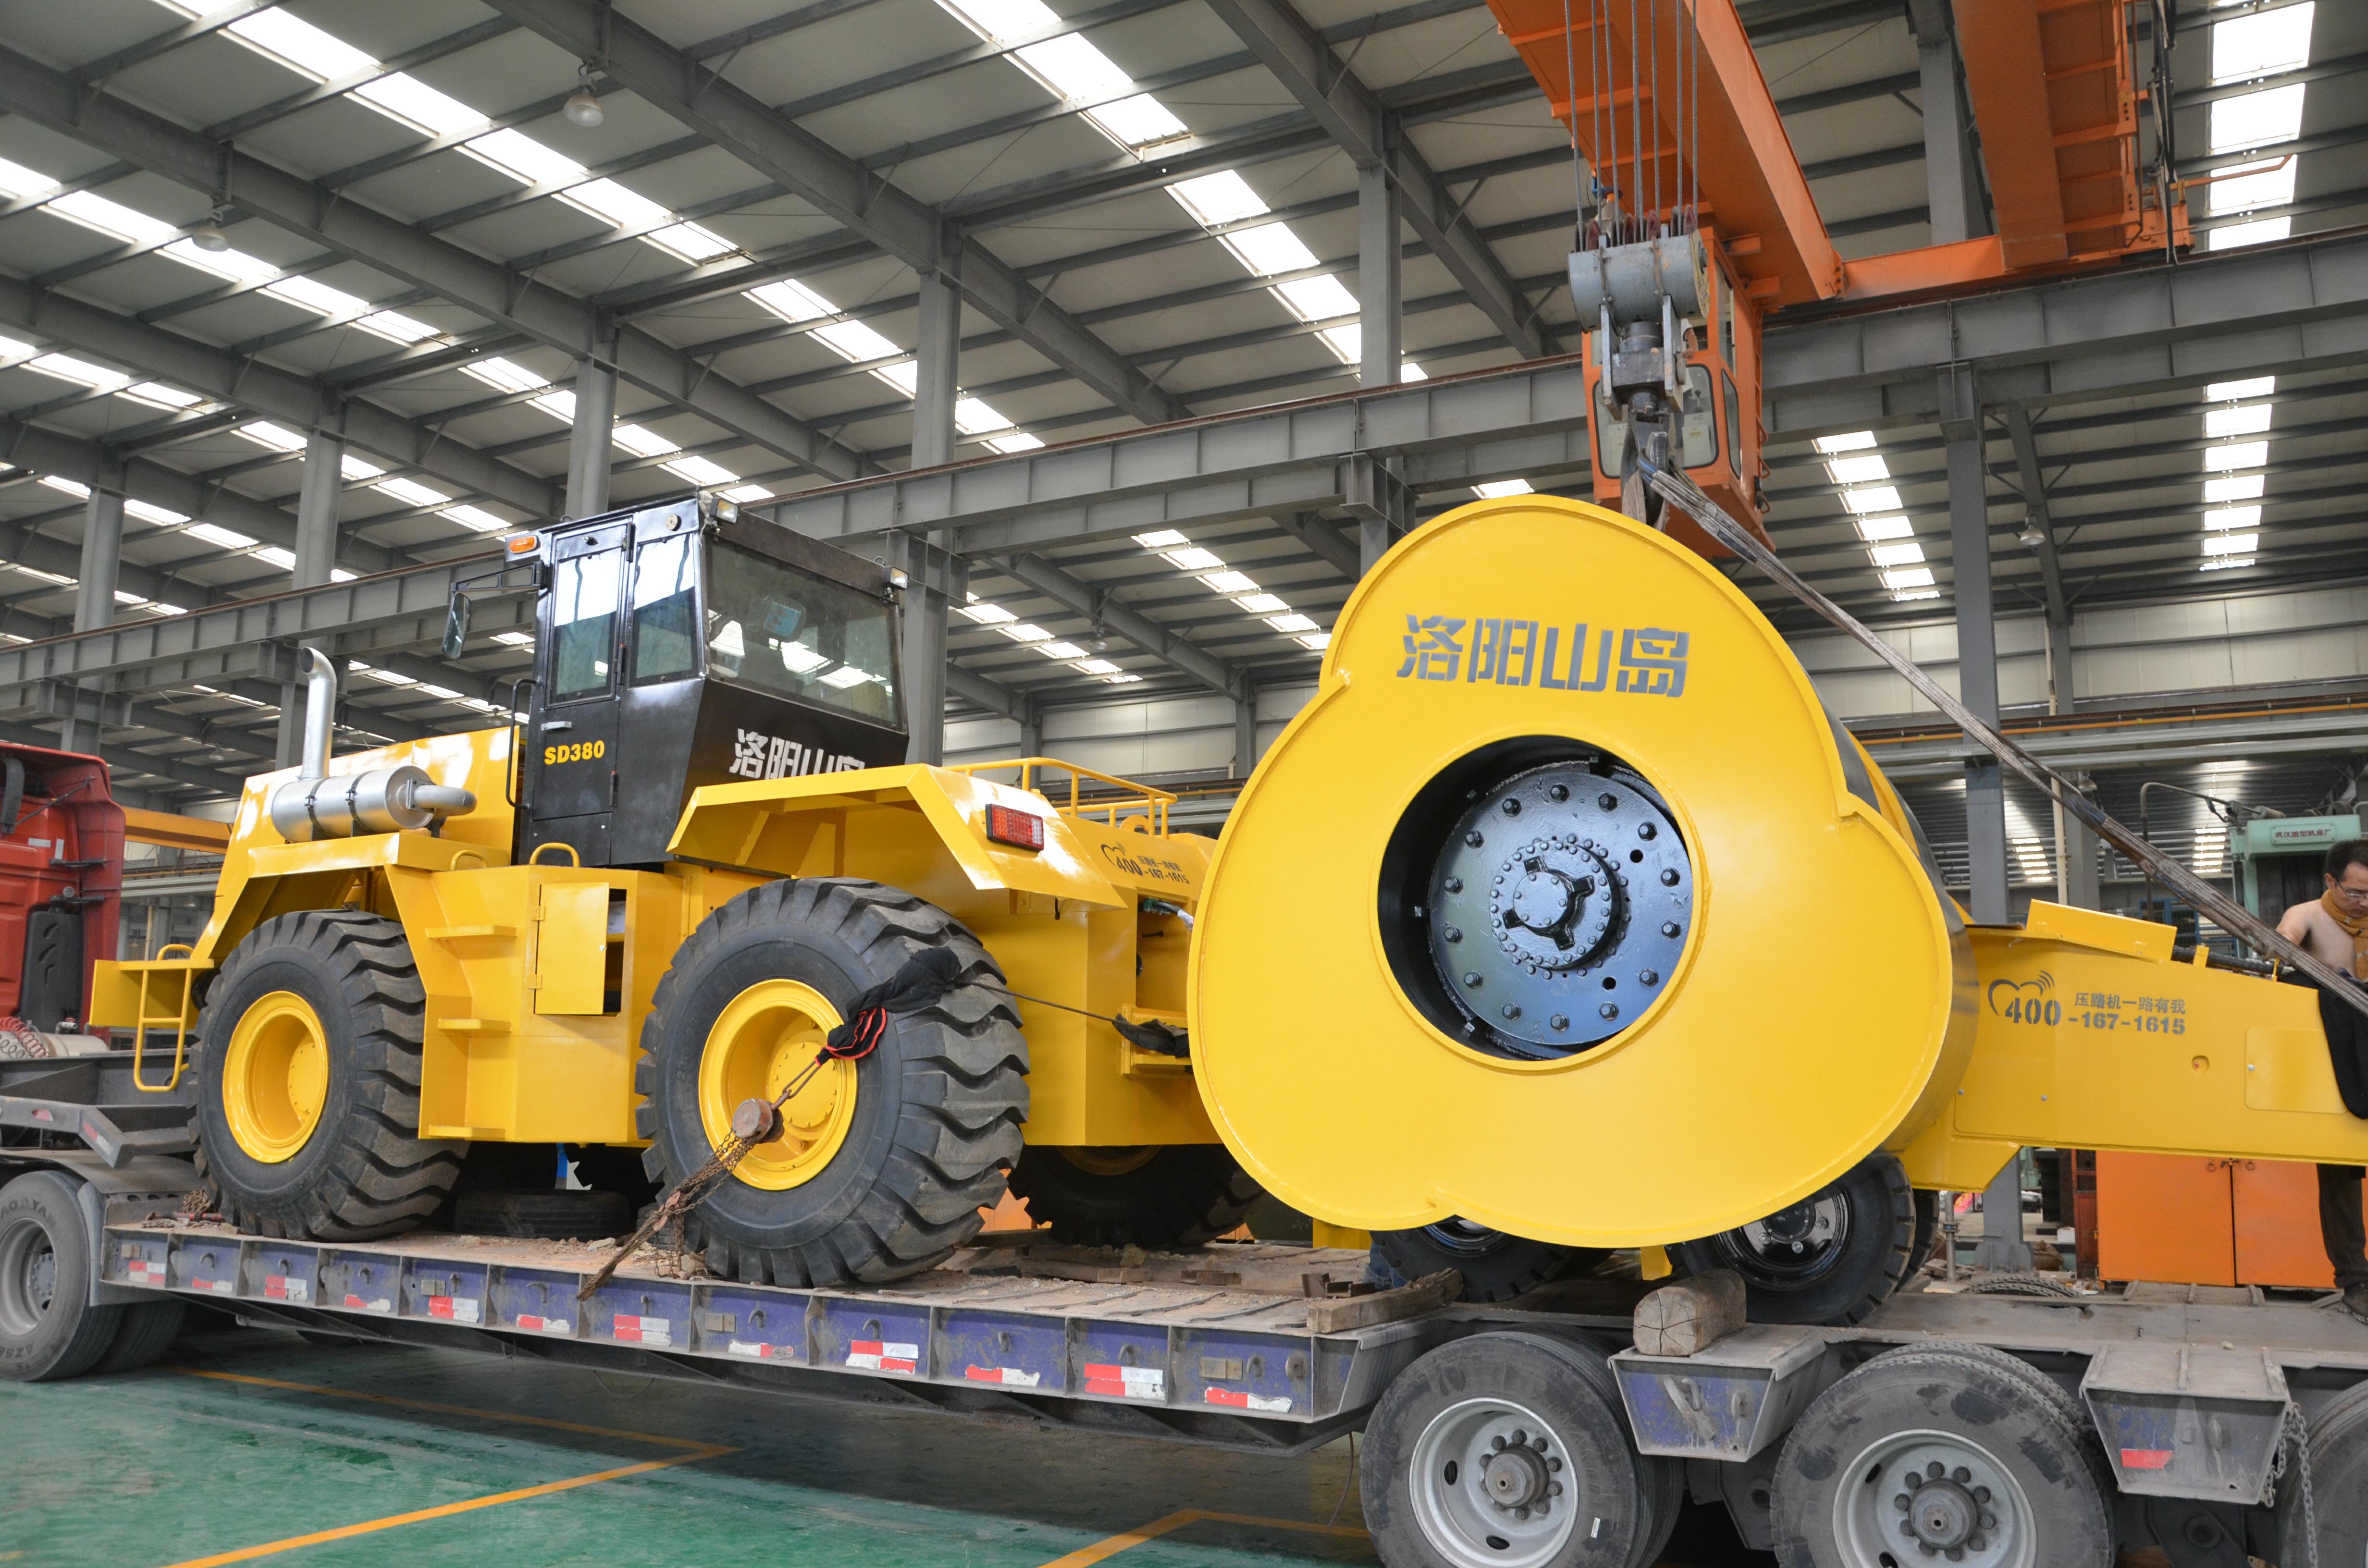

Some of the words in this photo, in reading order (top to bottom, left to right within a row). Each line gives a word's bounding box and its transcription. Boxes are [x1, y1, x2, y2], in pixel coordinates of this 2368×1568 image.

[1396, 614, 1690, 698] 洛阳山岛
[544, 740, 605, 765] SD380
[2074, 992, 2186, 1015] 压路机一路有我
